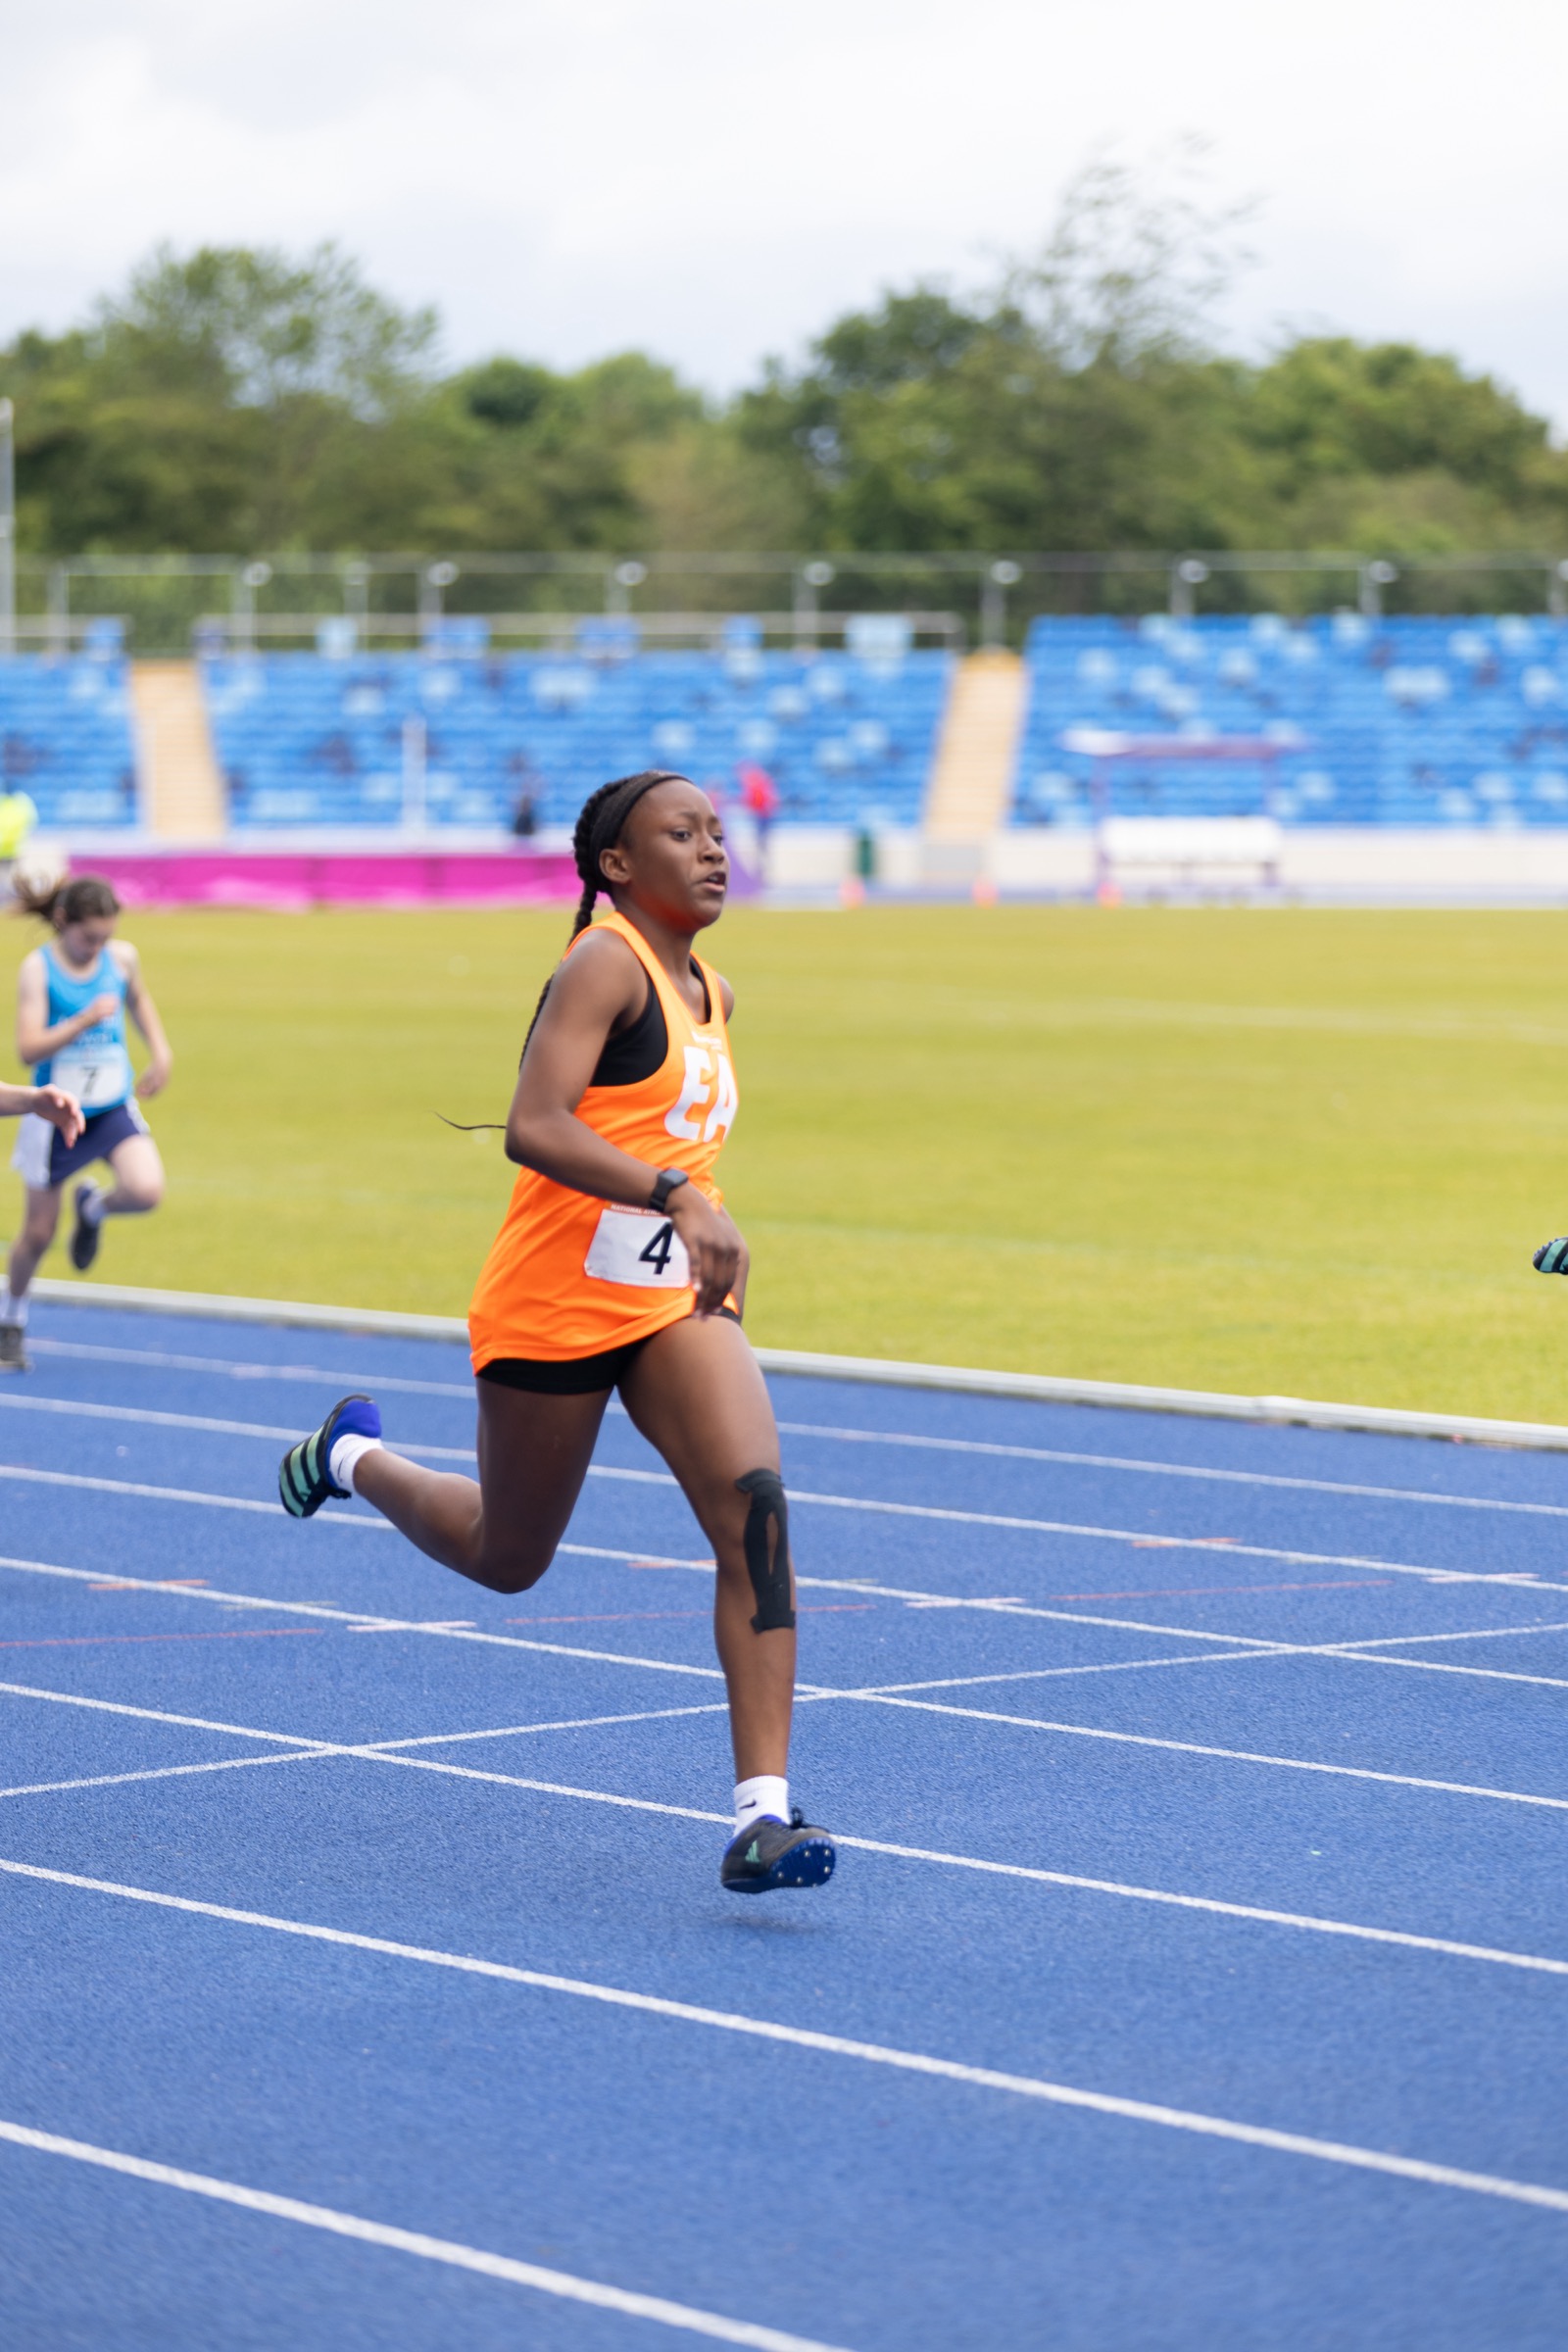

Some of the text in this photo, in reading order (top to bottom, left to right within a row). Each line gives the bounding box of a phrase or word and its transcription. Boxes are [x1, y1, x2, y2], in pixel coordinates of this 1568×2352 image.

[80, 1064, 100, 1095] 7
[663, 1046, 739, 1143] EA
[611, 1204, 643, 1214] NATIONAL
[637, 1220, 674, 1275] 4
